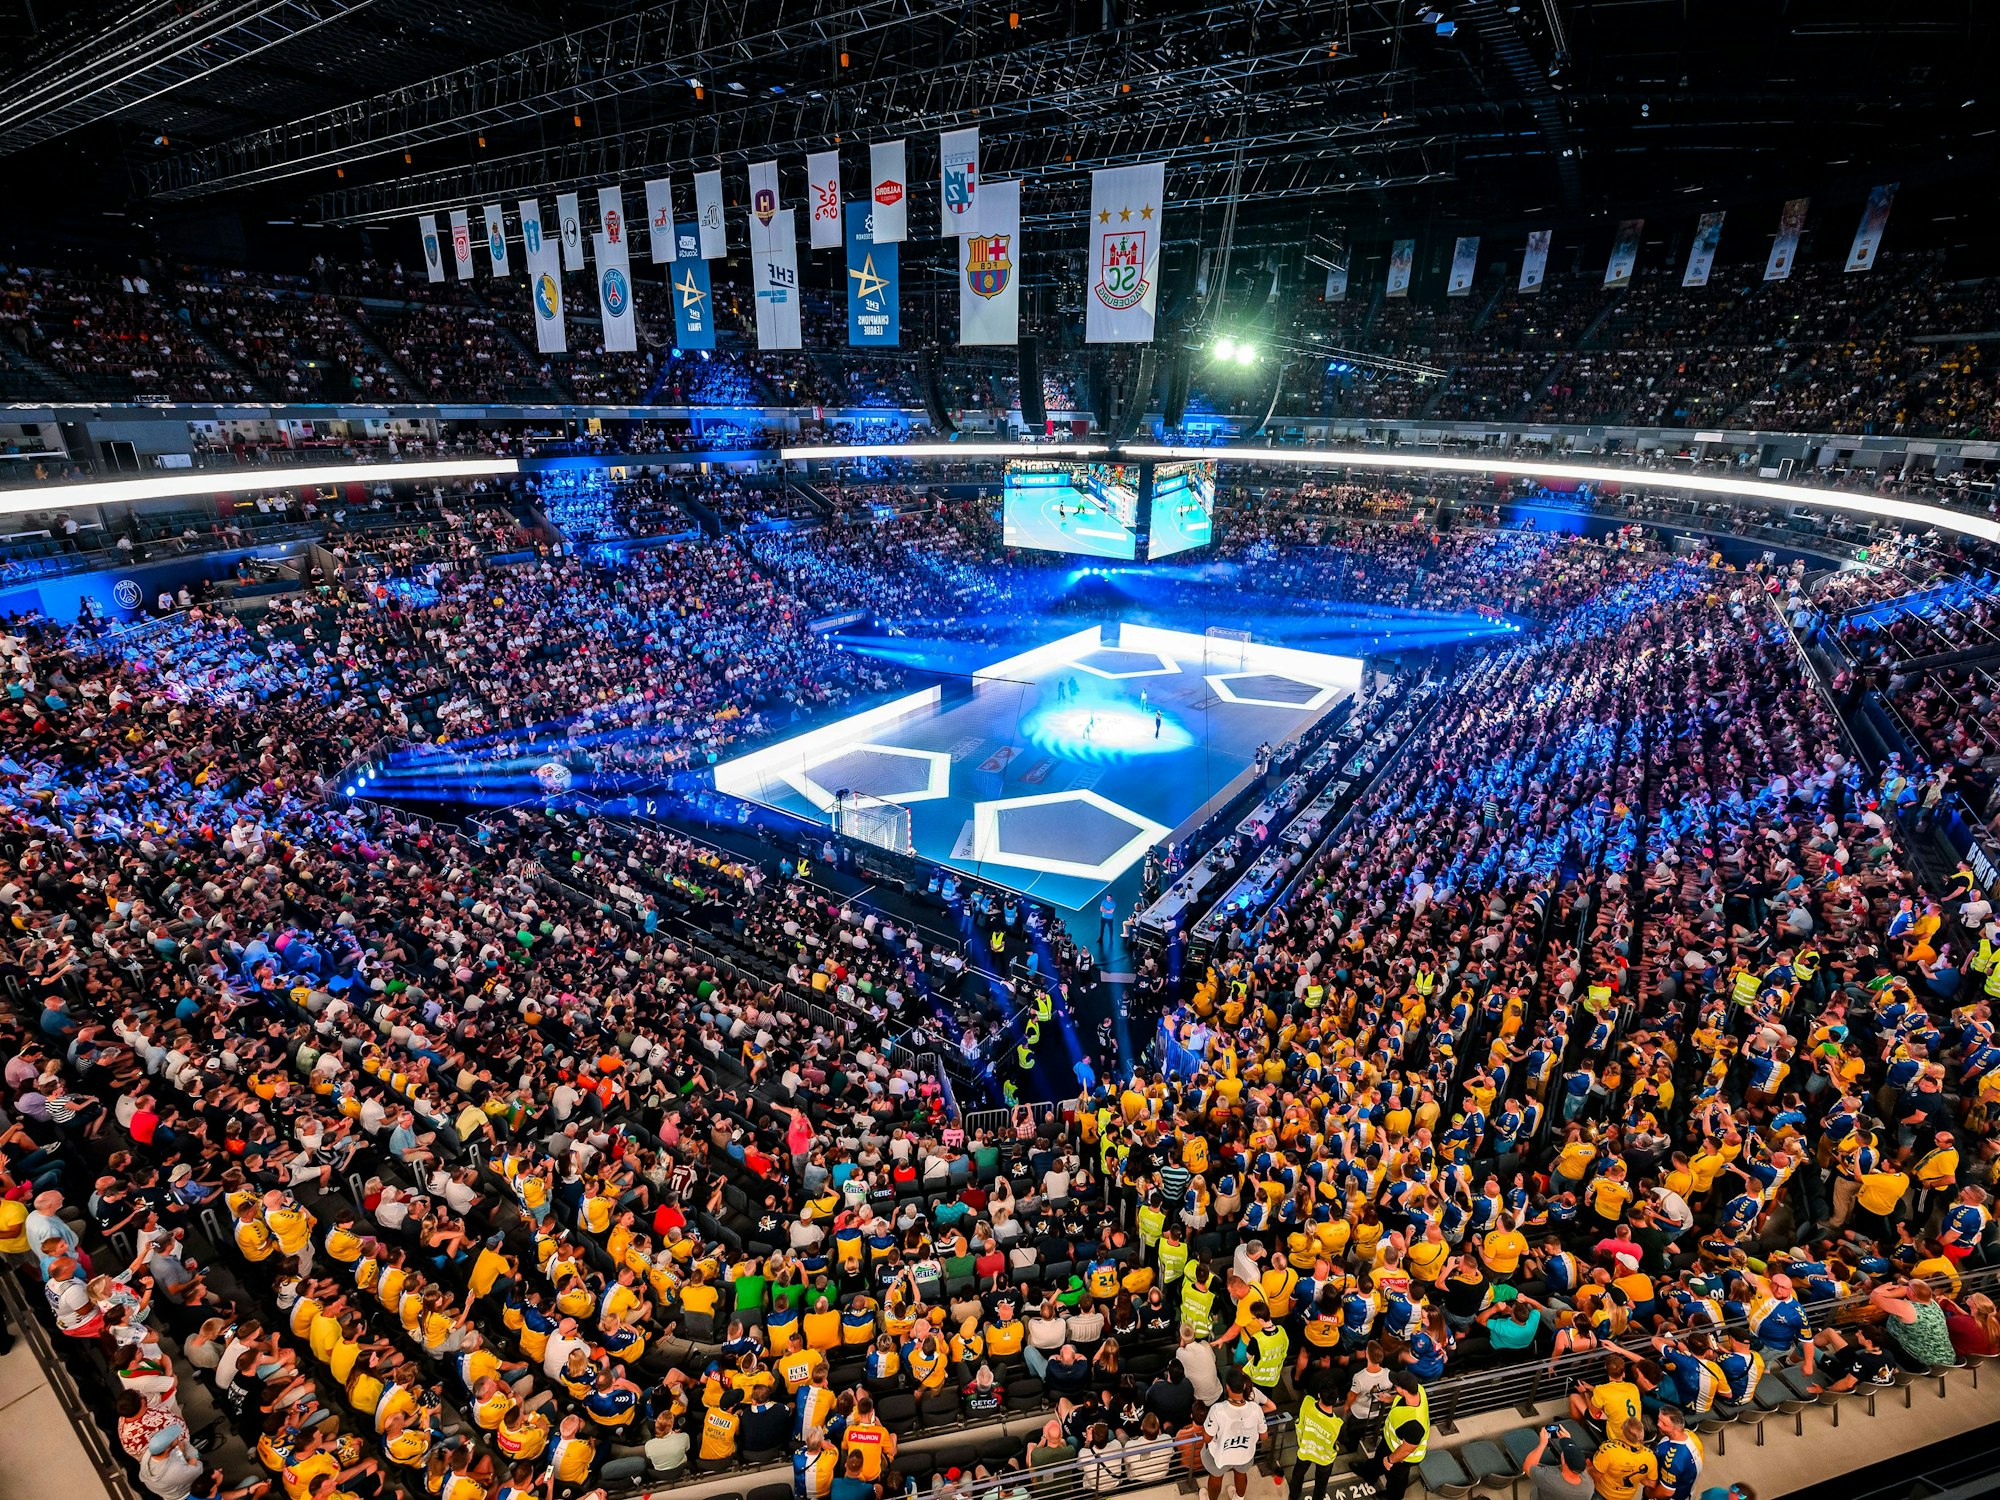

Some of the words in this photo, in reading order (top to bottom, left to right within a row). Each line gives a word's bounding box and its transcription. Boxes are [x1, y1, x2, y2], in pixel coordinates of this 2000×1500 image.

[116, 582, 135, 591] PARIS
[1972, 849, 1991, 883] PART
[1983, 867, 1997, 892] OF
[1195, 1150, 1205, 1161] 14
[671, 1174, 682, 1190] 11
[845, 1186, 863, 1194] GETEC
[873, 1190, 892, 1198] GETEC
[916, 1269, 937, 1278] GETEC
[1099, 1274, 1114, 1286] 24
[1710, 1288, 1725, 1301] 99
[1321, 1324, 1331, 1335] 2
[1626, 1399, 1636, 1418] 6
[500, 1436, 521, 1449] TAURON
[857, 1433, 879, 1442] TAURON
[1223, 1436, 1251, 1449] EHF
[1349, 1482, 1377, 1499] 216
